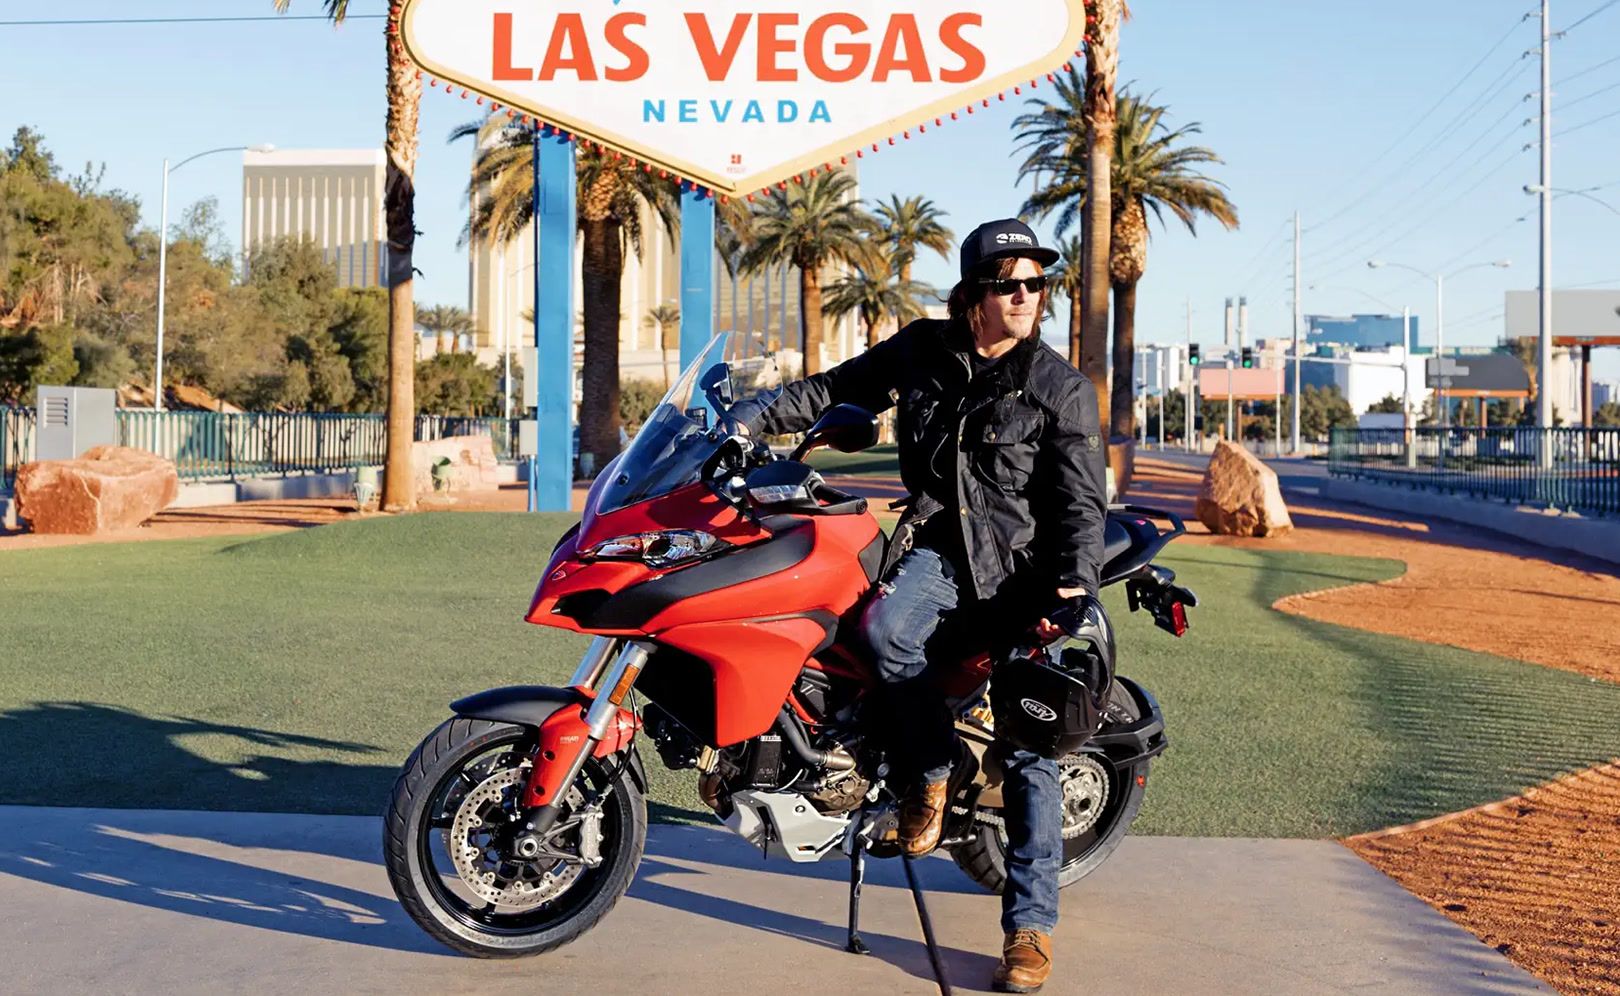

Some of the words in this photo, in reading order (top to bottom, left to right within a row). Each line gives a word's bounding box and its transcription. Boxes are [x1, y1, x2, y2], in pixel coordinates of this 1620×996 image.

[491, 12, 650, 83] LAS
[683, 12, 987, 84] VEGAS
[642, 99, 833, 124] NEVADA
